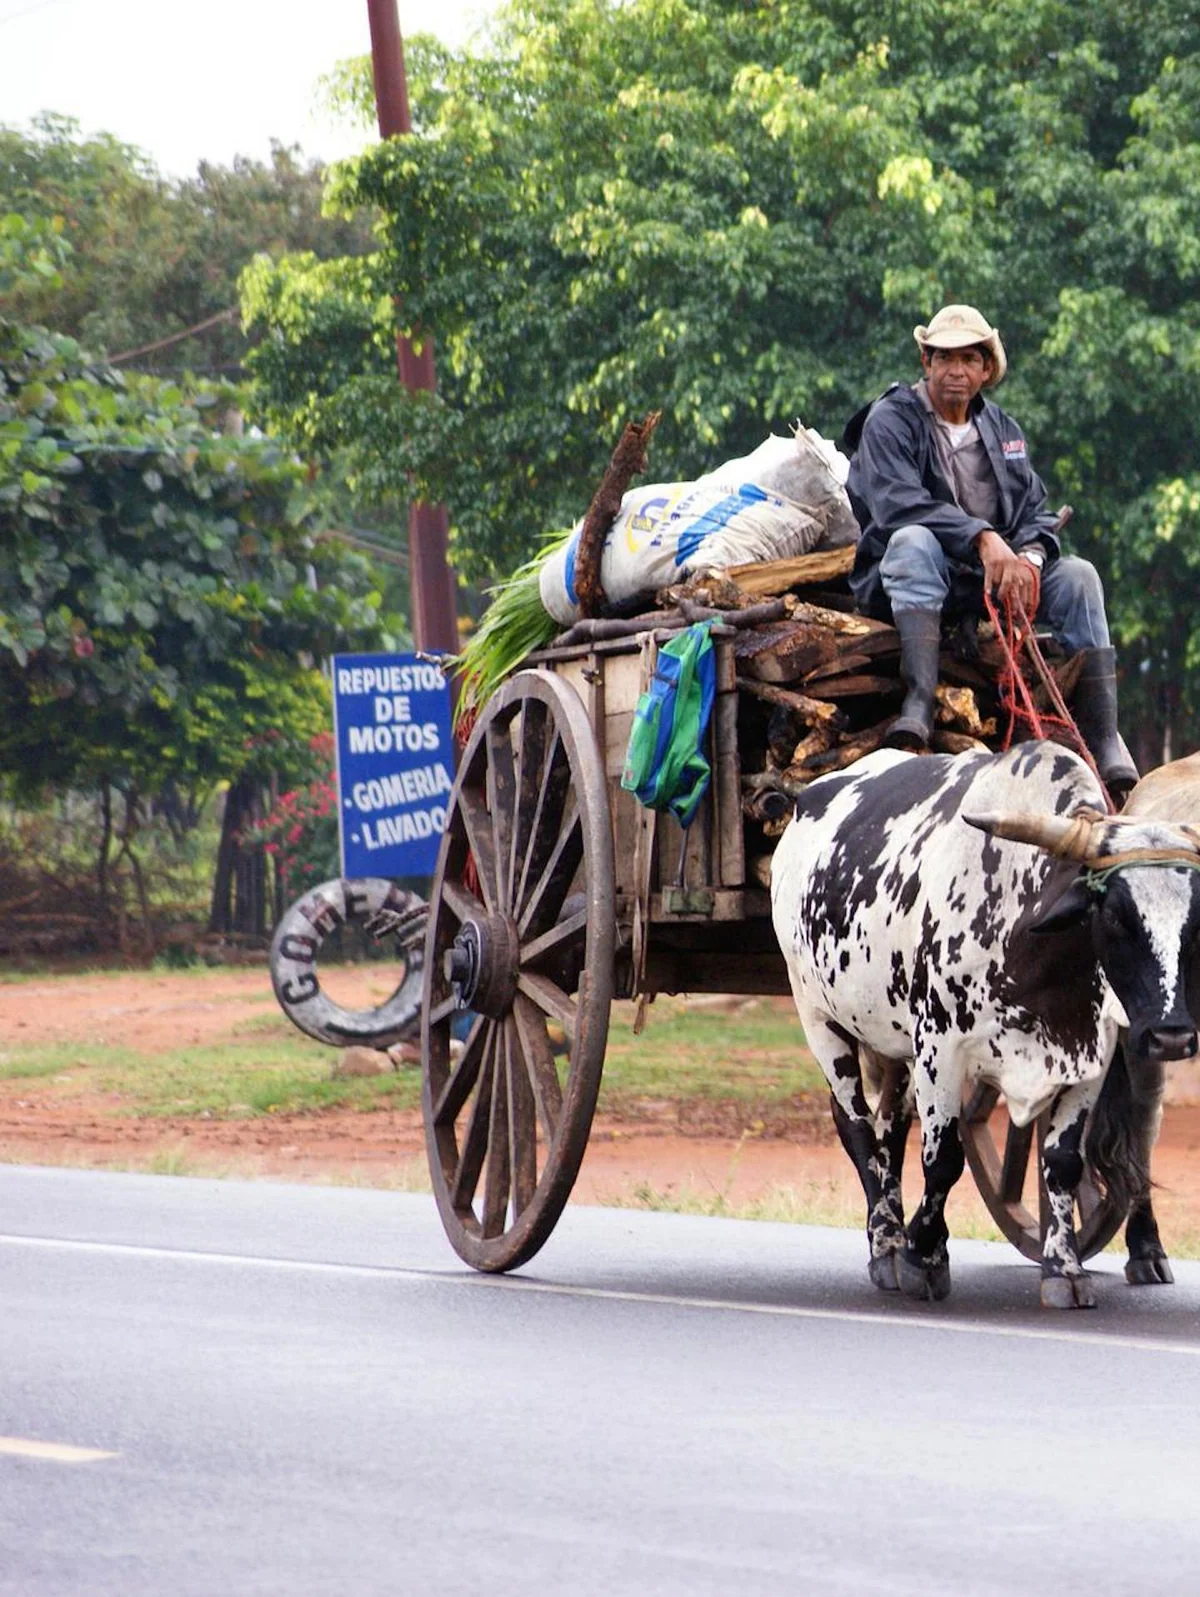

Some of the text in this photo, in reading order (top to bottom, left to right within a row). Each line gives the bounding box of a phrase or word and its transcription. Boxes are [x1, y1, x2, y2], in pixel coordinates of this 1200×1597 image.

[338, 665, 446, 695] REPUESTOS
[375, 695, 411, 723] DE
[348, 723, 440, 754] MOTOS
[353, 762, 451, 811] GOMERIA
[362, 806, 447, 850] LAVADO
